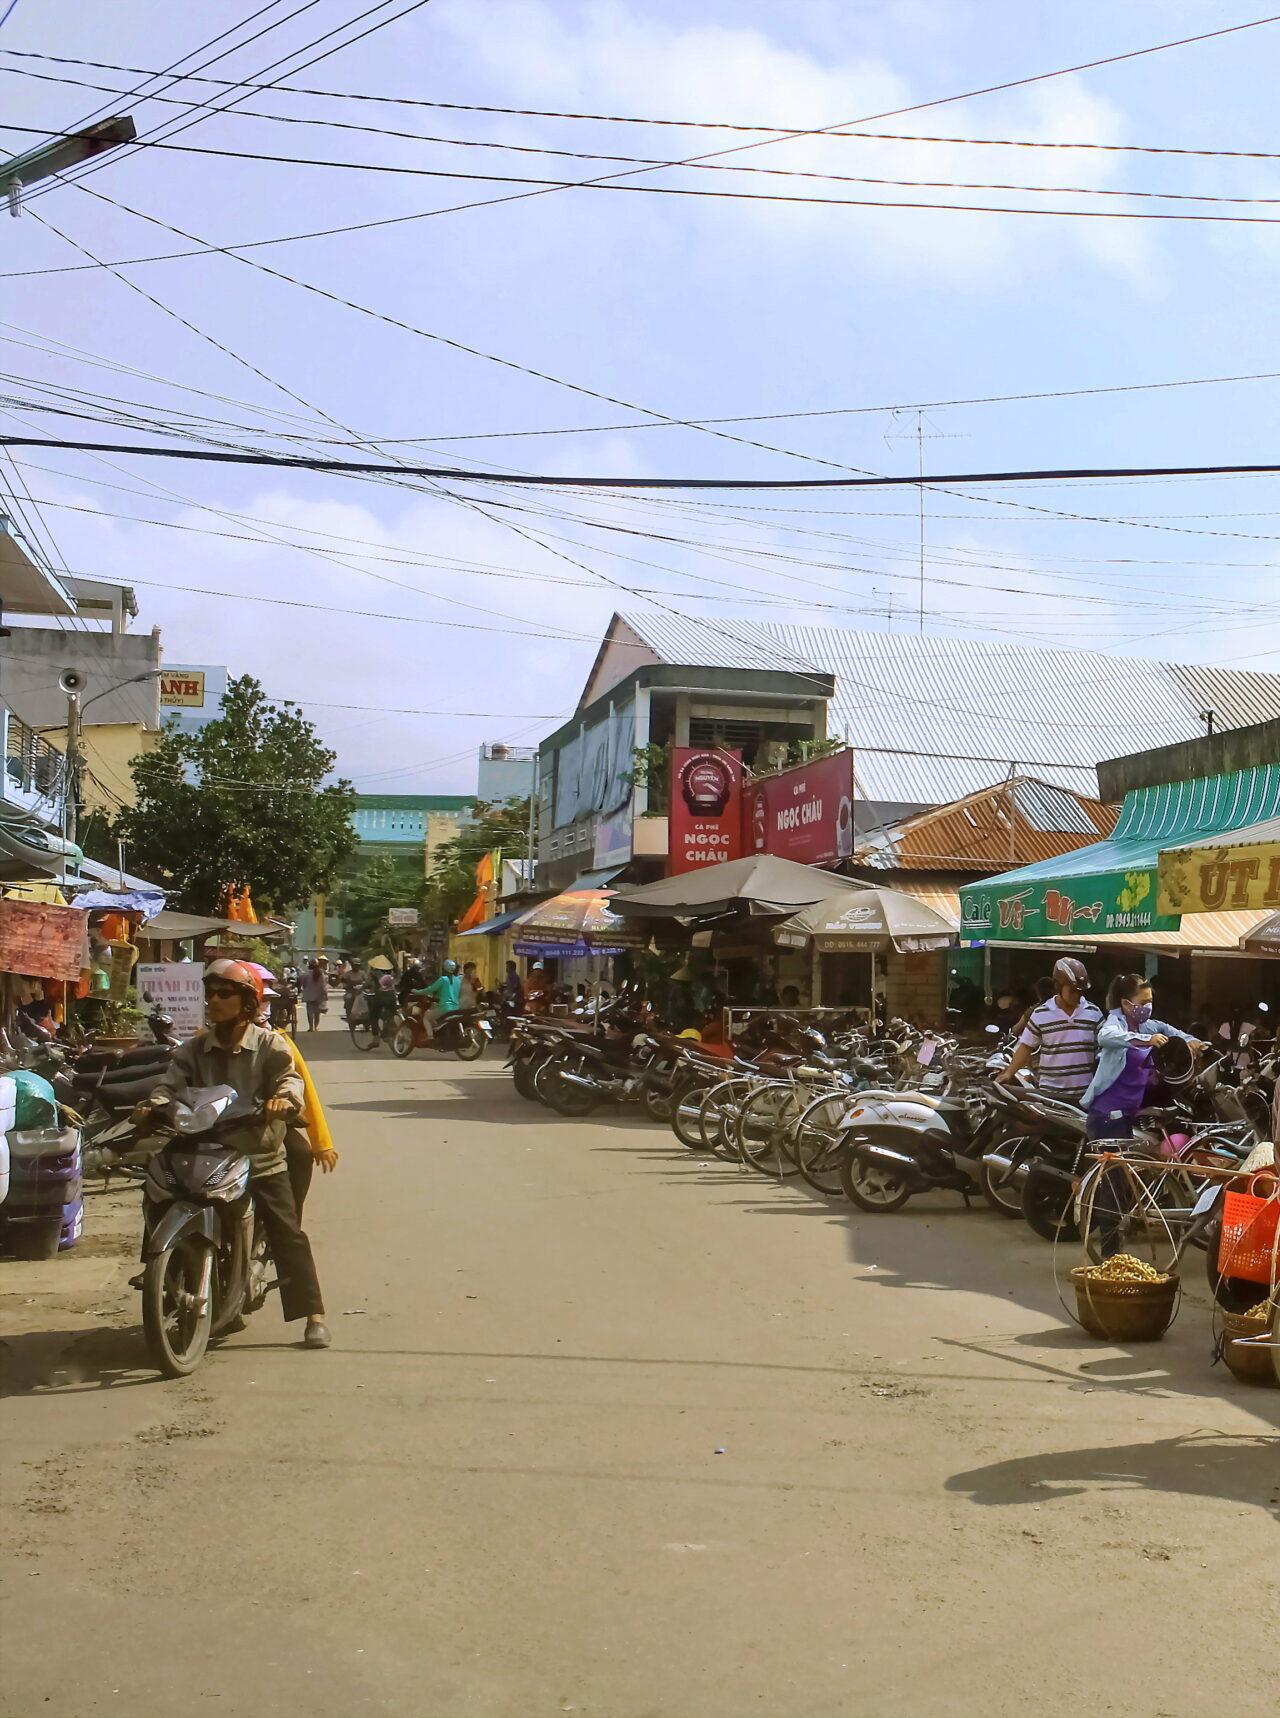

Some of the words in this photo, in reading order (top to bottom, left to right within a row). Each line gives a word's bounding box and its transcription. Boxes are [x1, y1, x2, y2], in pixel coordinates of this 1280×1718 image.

[777, 806, 800, 832] NGỌC
[684, 833, 730, 847] NGỌC
[685, 848, 728, 862] CHÂU
[1199, 850, 1260, 910] ÚT
